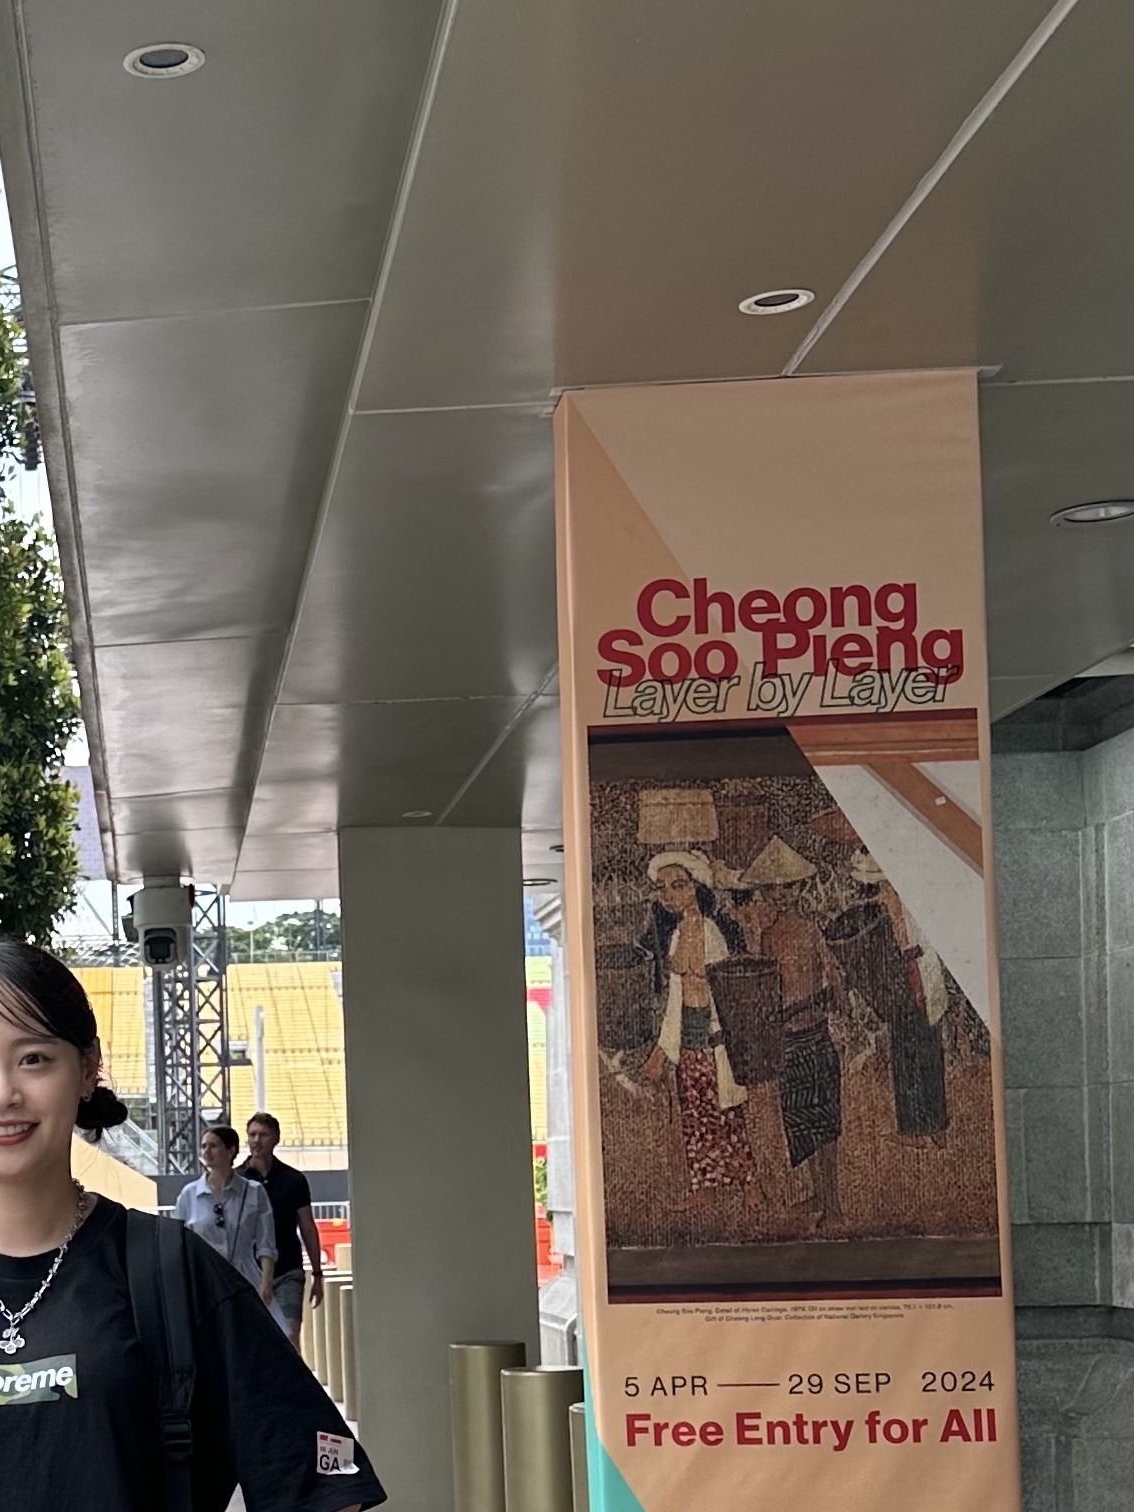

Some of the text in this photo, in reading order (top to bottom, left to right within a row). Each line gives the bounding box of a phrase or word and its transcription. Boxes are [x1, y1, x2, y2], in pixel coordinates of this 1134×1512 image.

[636, 577, 918, 635] Cheong
[596, 622, 964, 687] Soo Pieng
[602, 657, 961, 723] Layer by Layer
[624, 1376, 640, 1397] 5
[650, 1375, 708, 1397] APR
[788, 1374, 824, 1395] 29
[834, 1372, 892, 1394] SEP
[921, 1370, 995, 1393] 2024
[625, 1408, 997, 1452] Free Entry for All
[319, 1454, 341, 1472] GA
